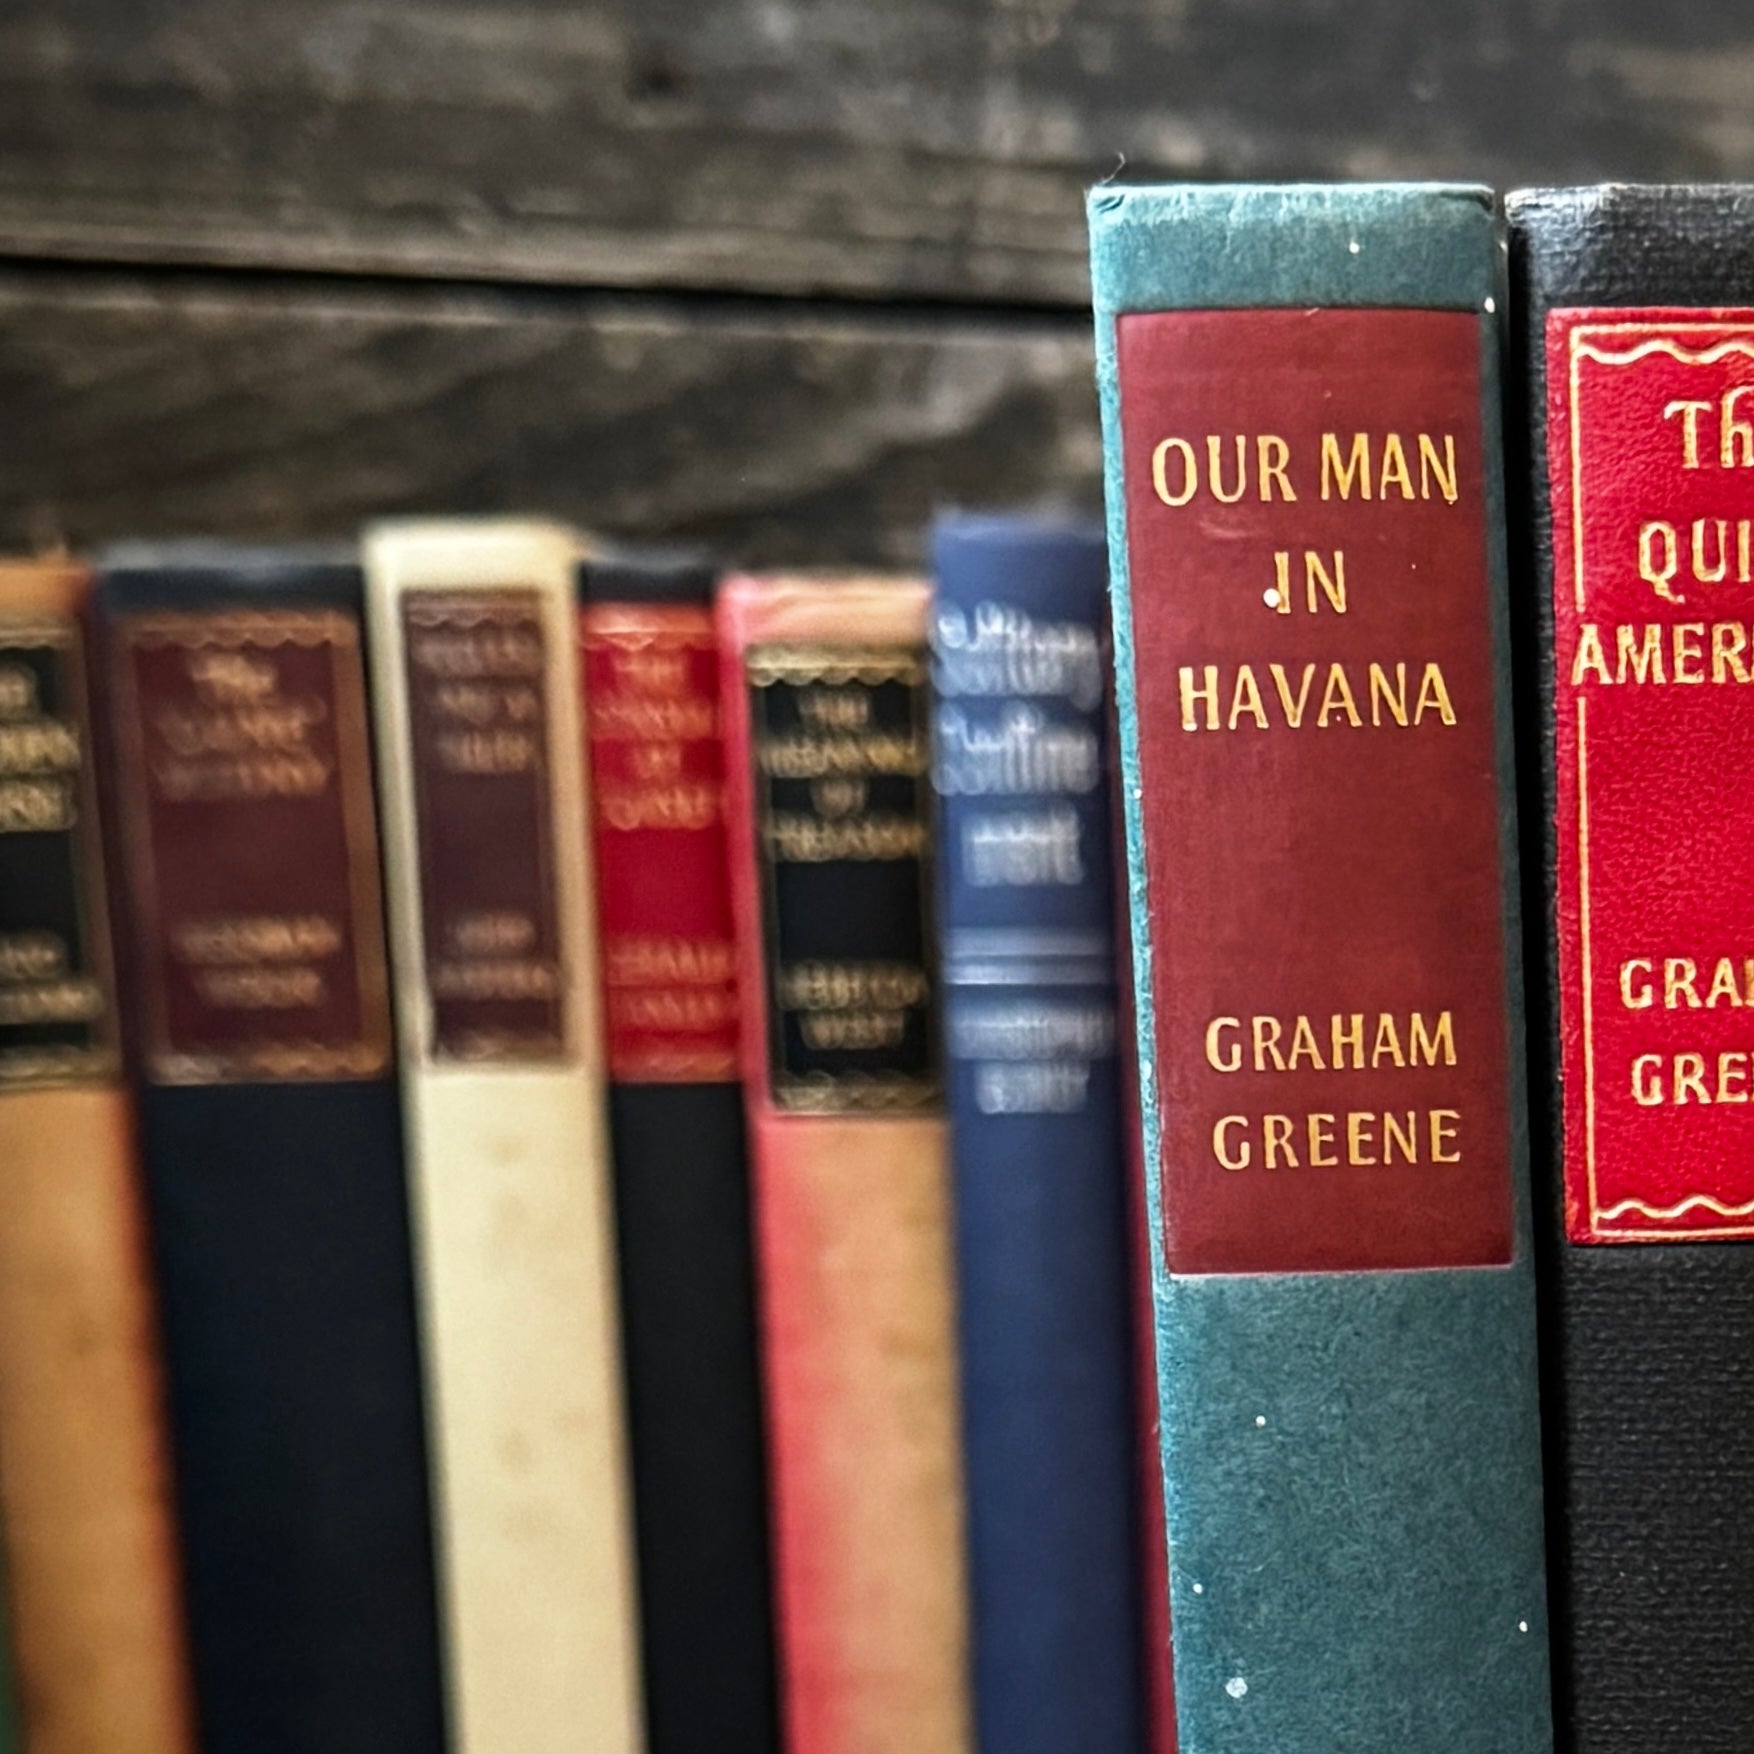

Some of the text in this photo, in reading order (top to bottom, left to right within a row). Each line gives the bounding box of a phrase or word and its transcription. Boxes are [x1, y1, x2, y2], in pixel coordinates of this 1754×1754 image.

[1152, 432, 1459, 507] OUR MAN
[1273, 550, 1348, 615] IN
[1178, 662, 1458, 732] HAVANA
[1205, 1011, 1457, 1072] GRAHAM
[1212, 1109, 1462, 1170] GREENE
